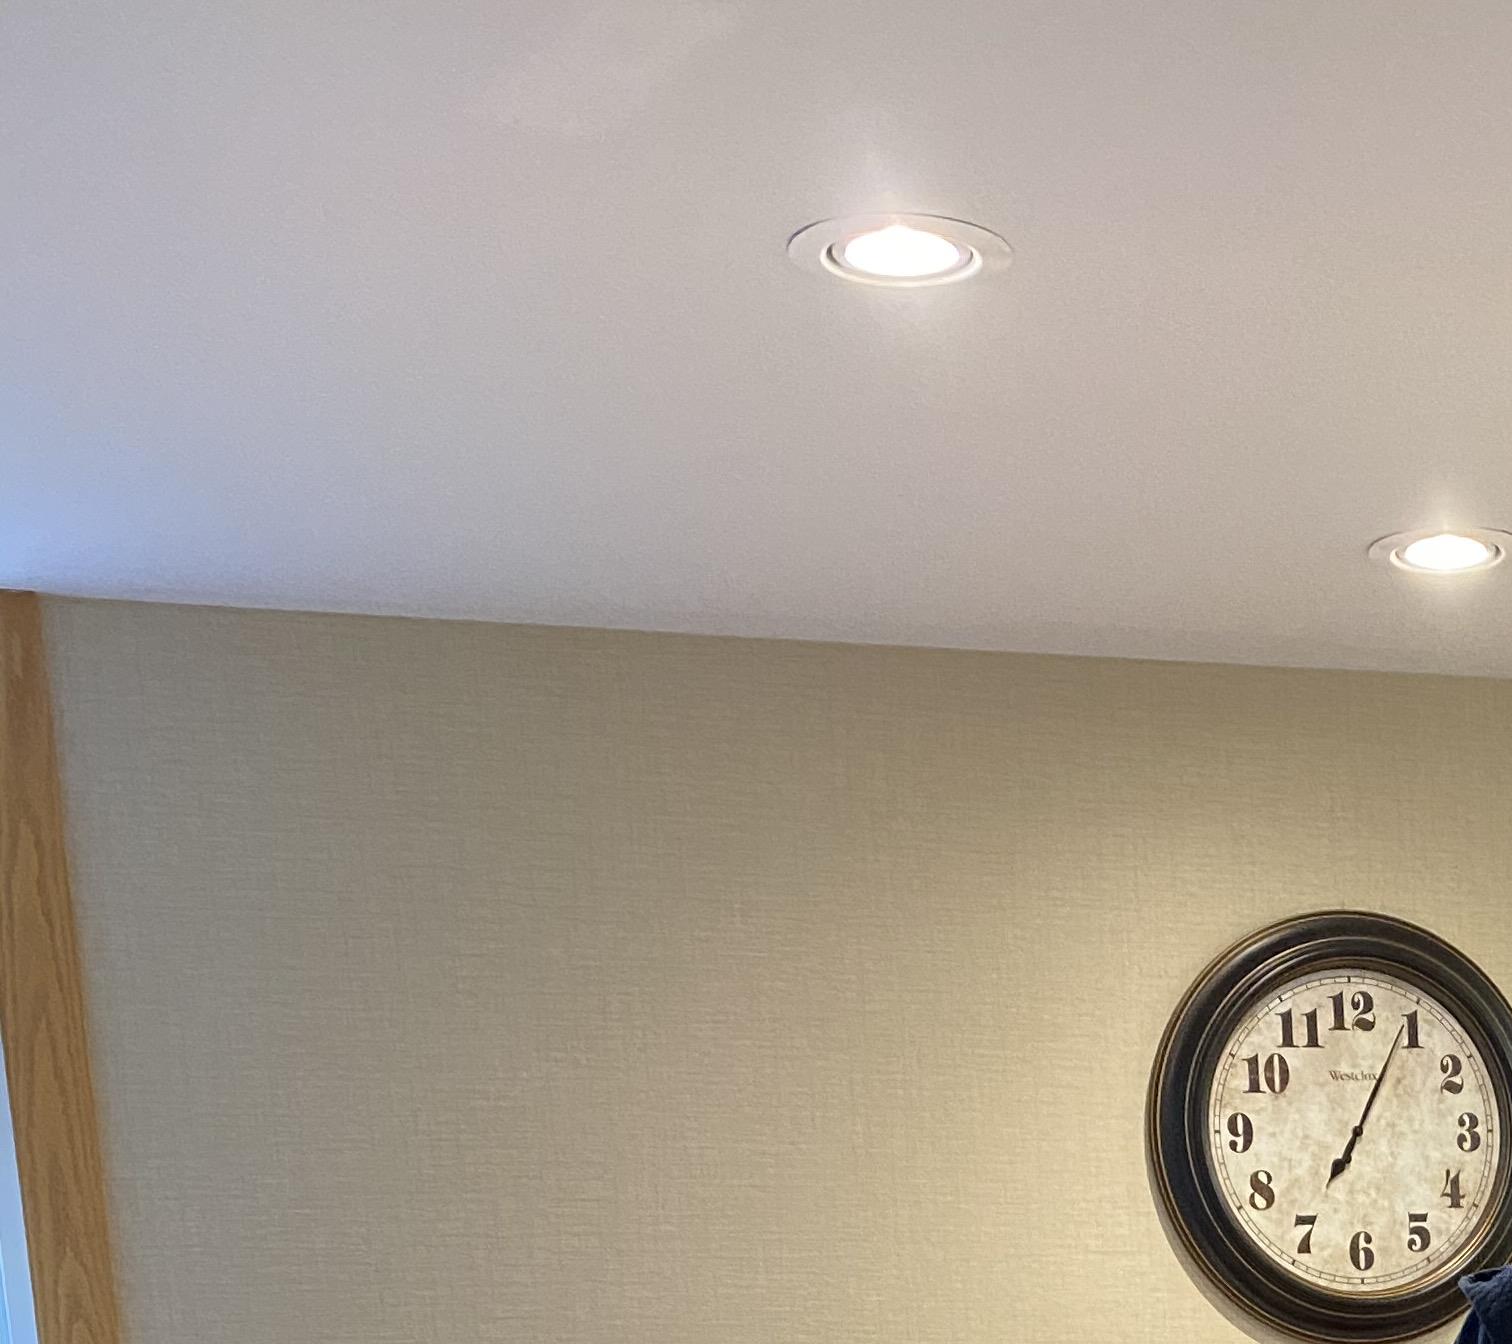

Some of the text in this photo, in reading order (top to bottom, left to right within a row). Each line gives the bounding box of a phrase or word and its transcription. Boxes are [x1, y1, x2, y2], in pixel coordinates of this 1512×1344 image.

[1275, 1008, 1325, 1048] 11
[1328, 990, 1377, 1031] 12
[1401, 1010, 1424, 1049] 1
[1242, 1053, 1290, 1094] 10
[1440, 1054, 1465, 1095] 2
[1227, 1112, 1254, 1153] 9
[1457, 1112, 1481, 1152] 3
[1249, 1170, 1276, 1210] 8
[1440, 1169, 1466, 1208] 4
[1294, 1214, 1318, 1254] 7
[1349, 1231, 1375, 1271] 6
[1408, 1212, 1431, 1252] 5
